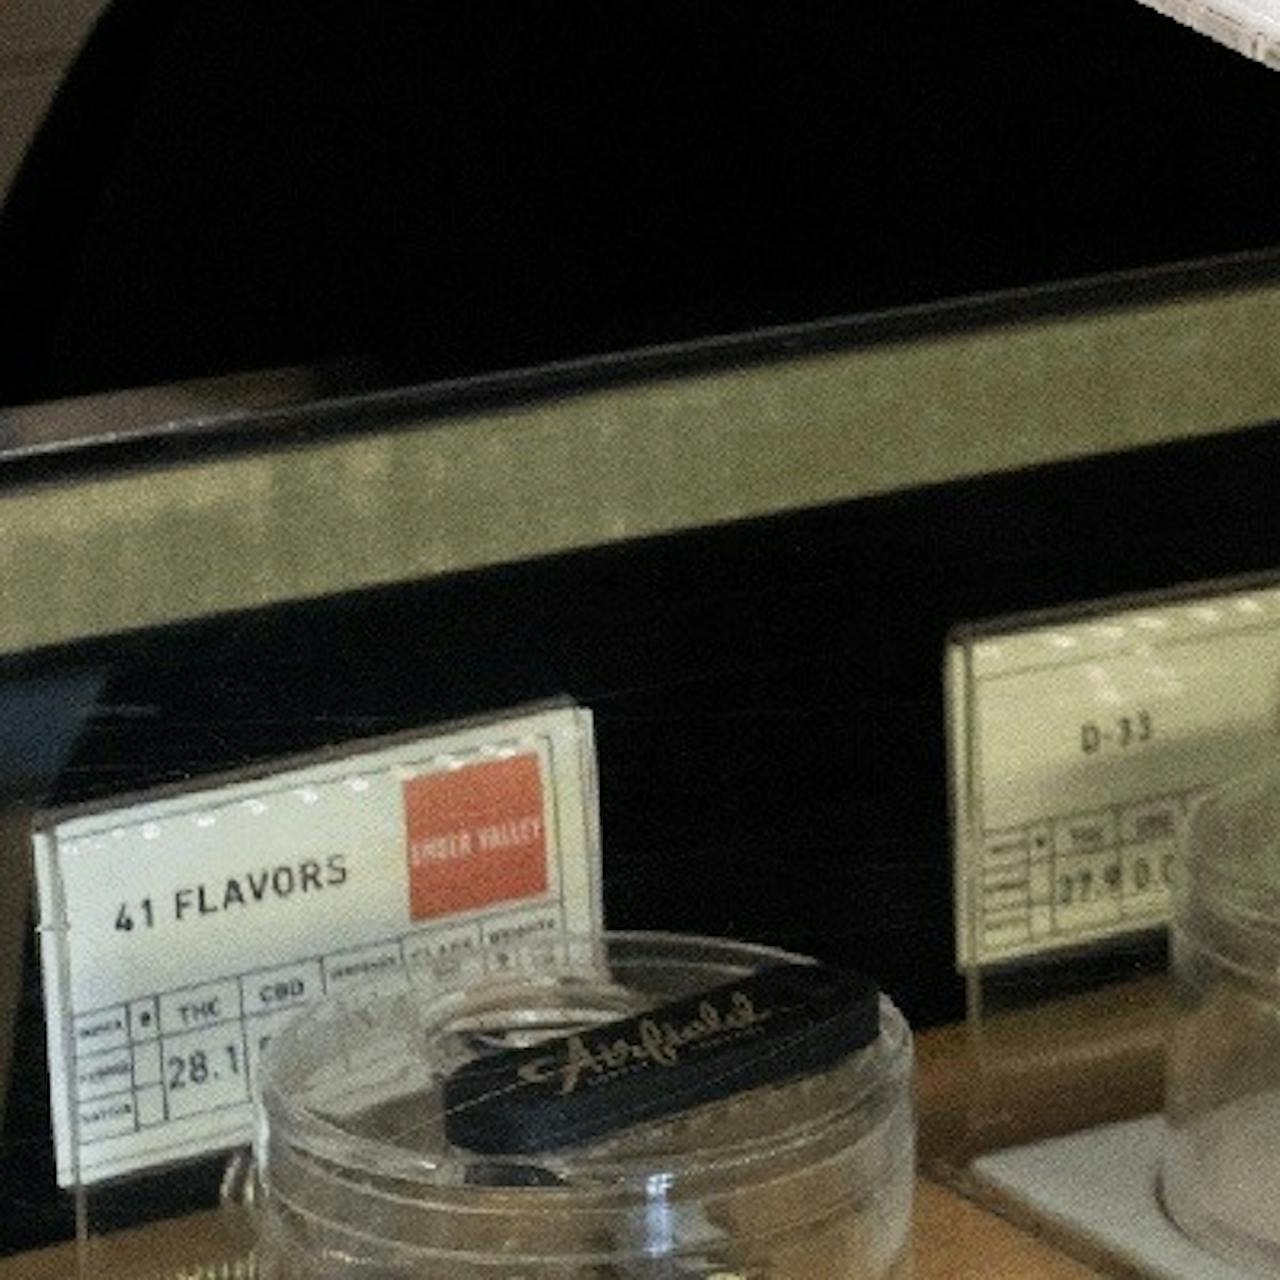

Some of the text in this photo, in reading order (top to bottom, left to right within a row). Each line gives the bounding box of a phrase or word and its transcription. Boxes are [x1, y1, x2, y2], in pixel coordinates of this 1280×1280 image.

[115, 853, 348, 931] 41 FLAVORS
[167, 1041, 239, 1090] 28.1
